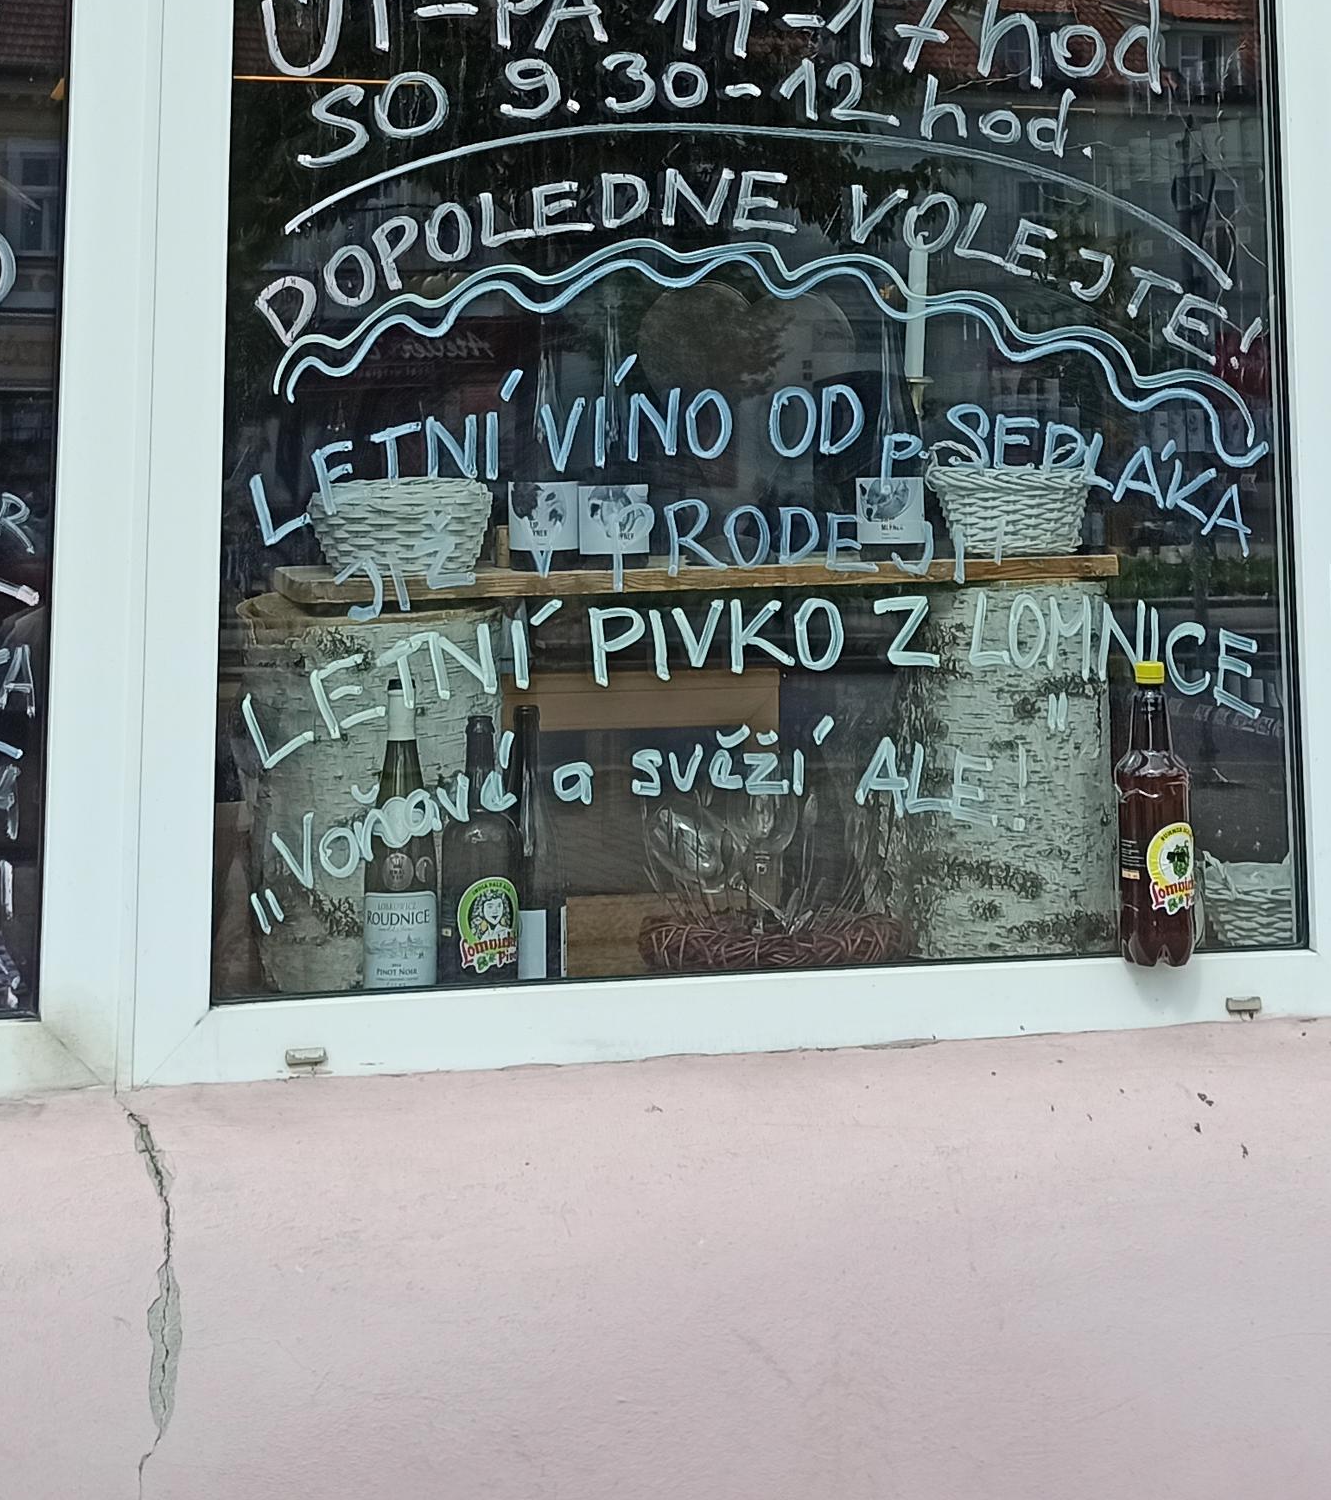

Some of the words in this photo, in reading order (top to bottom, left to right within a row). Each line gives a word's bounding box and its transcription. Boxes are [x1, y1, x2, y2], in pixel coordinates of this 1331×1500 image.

[297, 71, 450, 168] SO
[920, 73, 1092, 159] hod.
[254, 167, 798, 347] DOPOLEDNE
[249, 368, 524, 547] LETNÍ
[541, 354, 734, 473] VÍNO
[768, 384, 866, 459] OD
[945, 403, 1254, 559] SEDLÁKA
[241, 598, 563, 769] LETNÍ
[587, 595, 845, 688] PIVKO
[873, 594, 942, 669] Z
[968, 591, 1262, 720] LOMNICE
[552, 760, 595, 806] a
[631, 714, 835, 797] svěží
[367, 909, 430, 926] ROUDNICE
